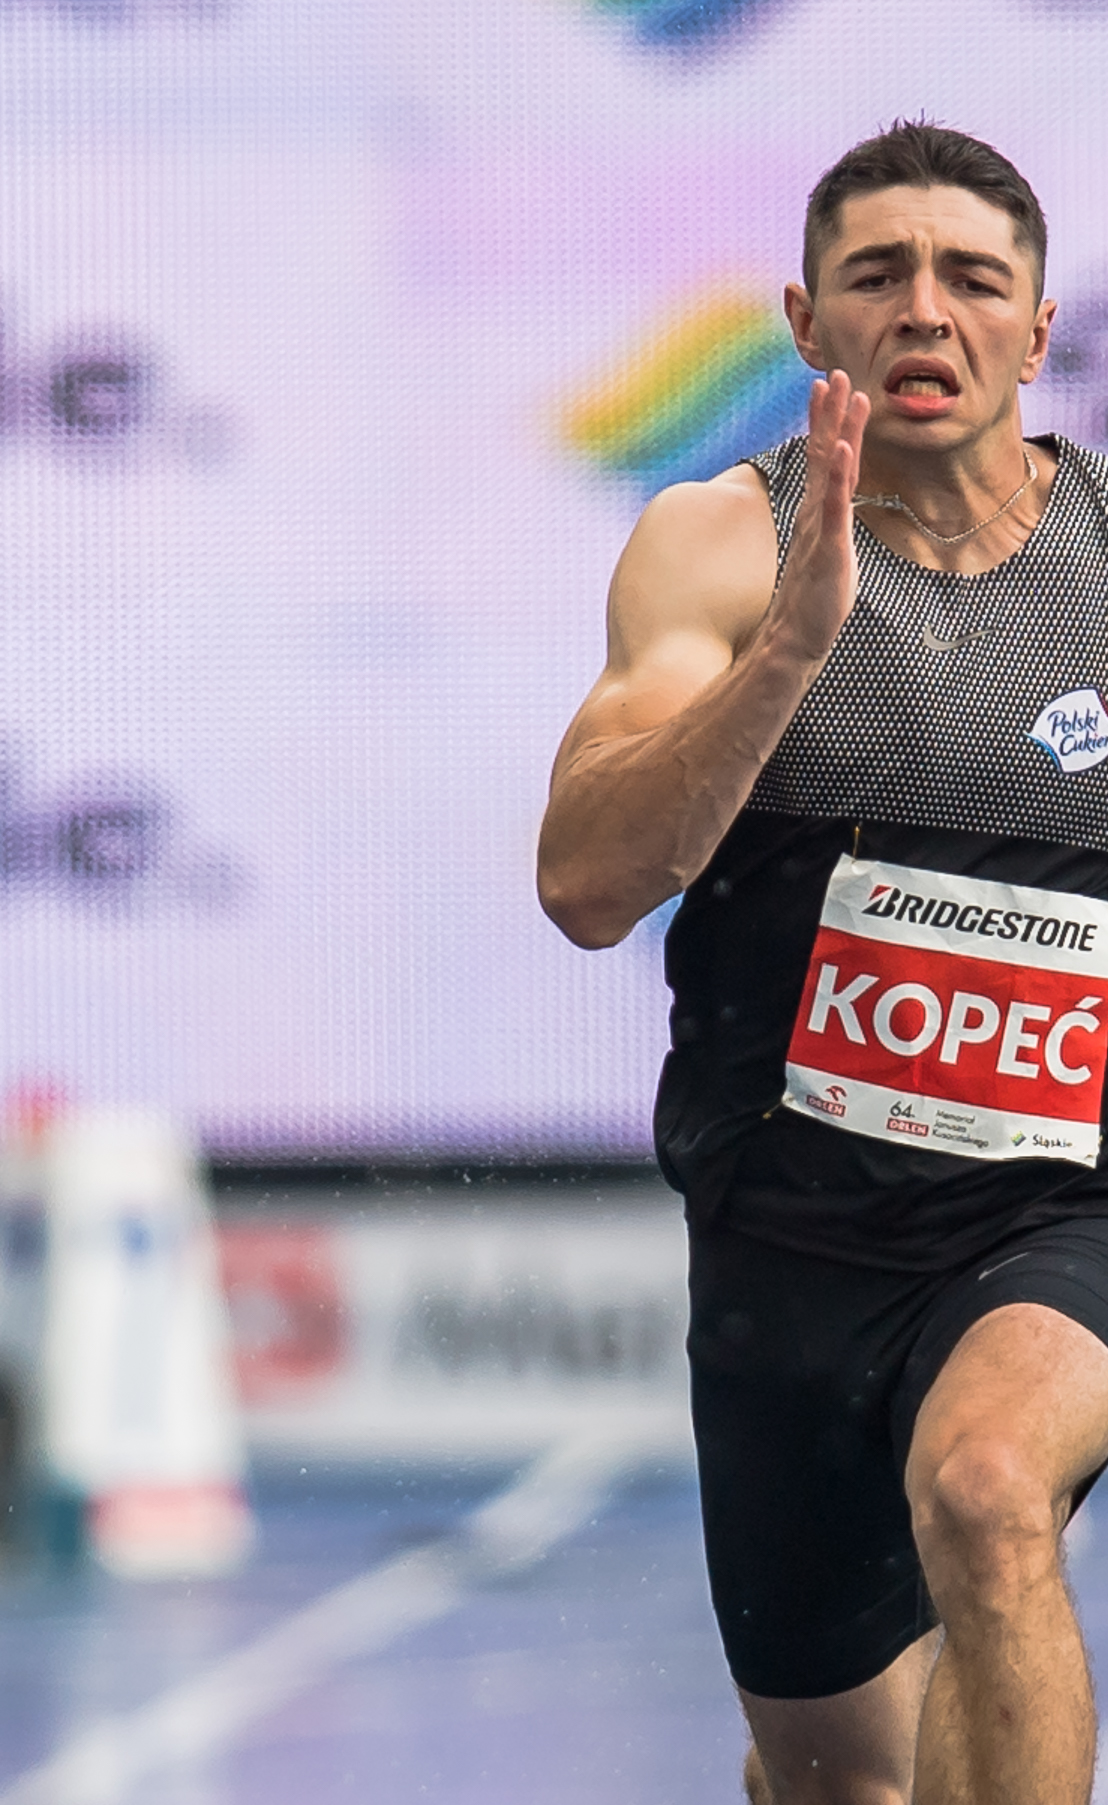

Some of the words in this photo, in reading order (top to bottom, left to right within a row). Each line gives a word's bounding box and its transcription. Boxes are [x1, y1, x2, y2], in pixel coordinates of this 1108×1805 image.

[1047, 707, 1100, 738] Polski
[861, 884, 1099, 952] BRIDGESTONE
[807, 963, 1103, 1085] KOPEĆ
[808, 1097, 844, 1116] ORLEN
[890, 1100, 916, 1118] 64.
[888, 1119, 928, 1136] ORLEN
